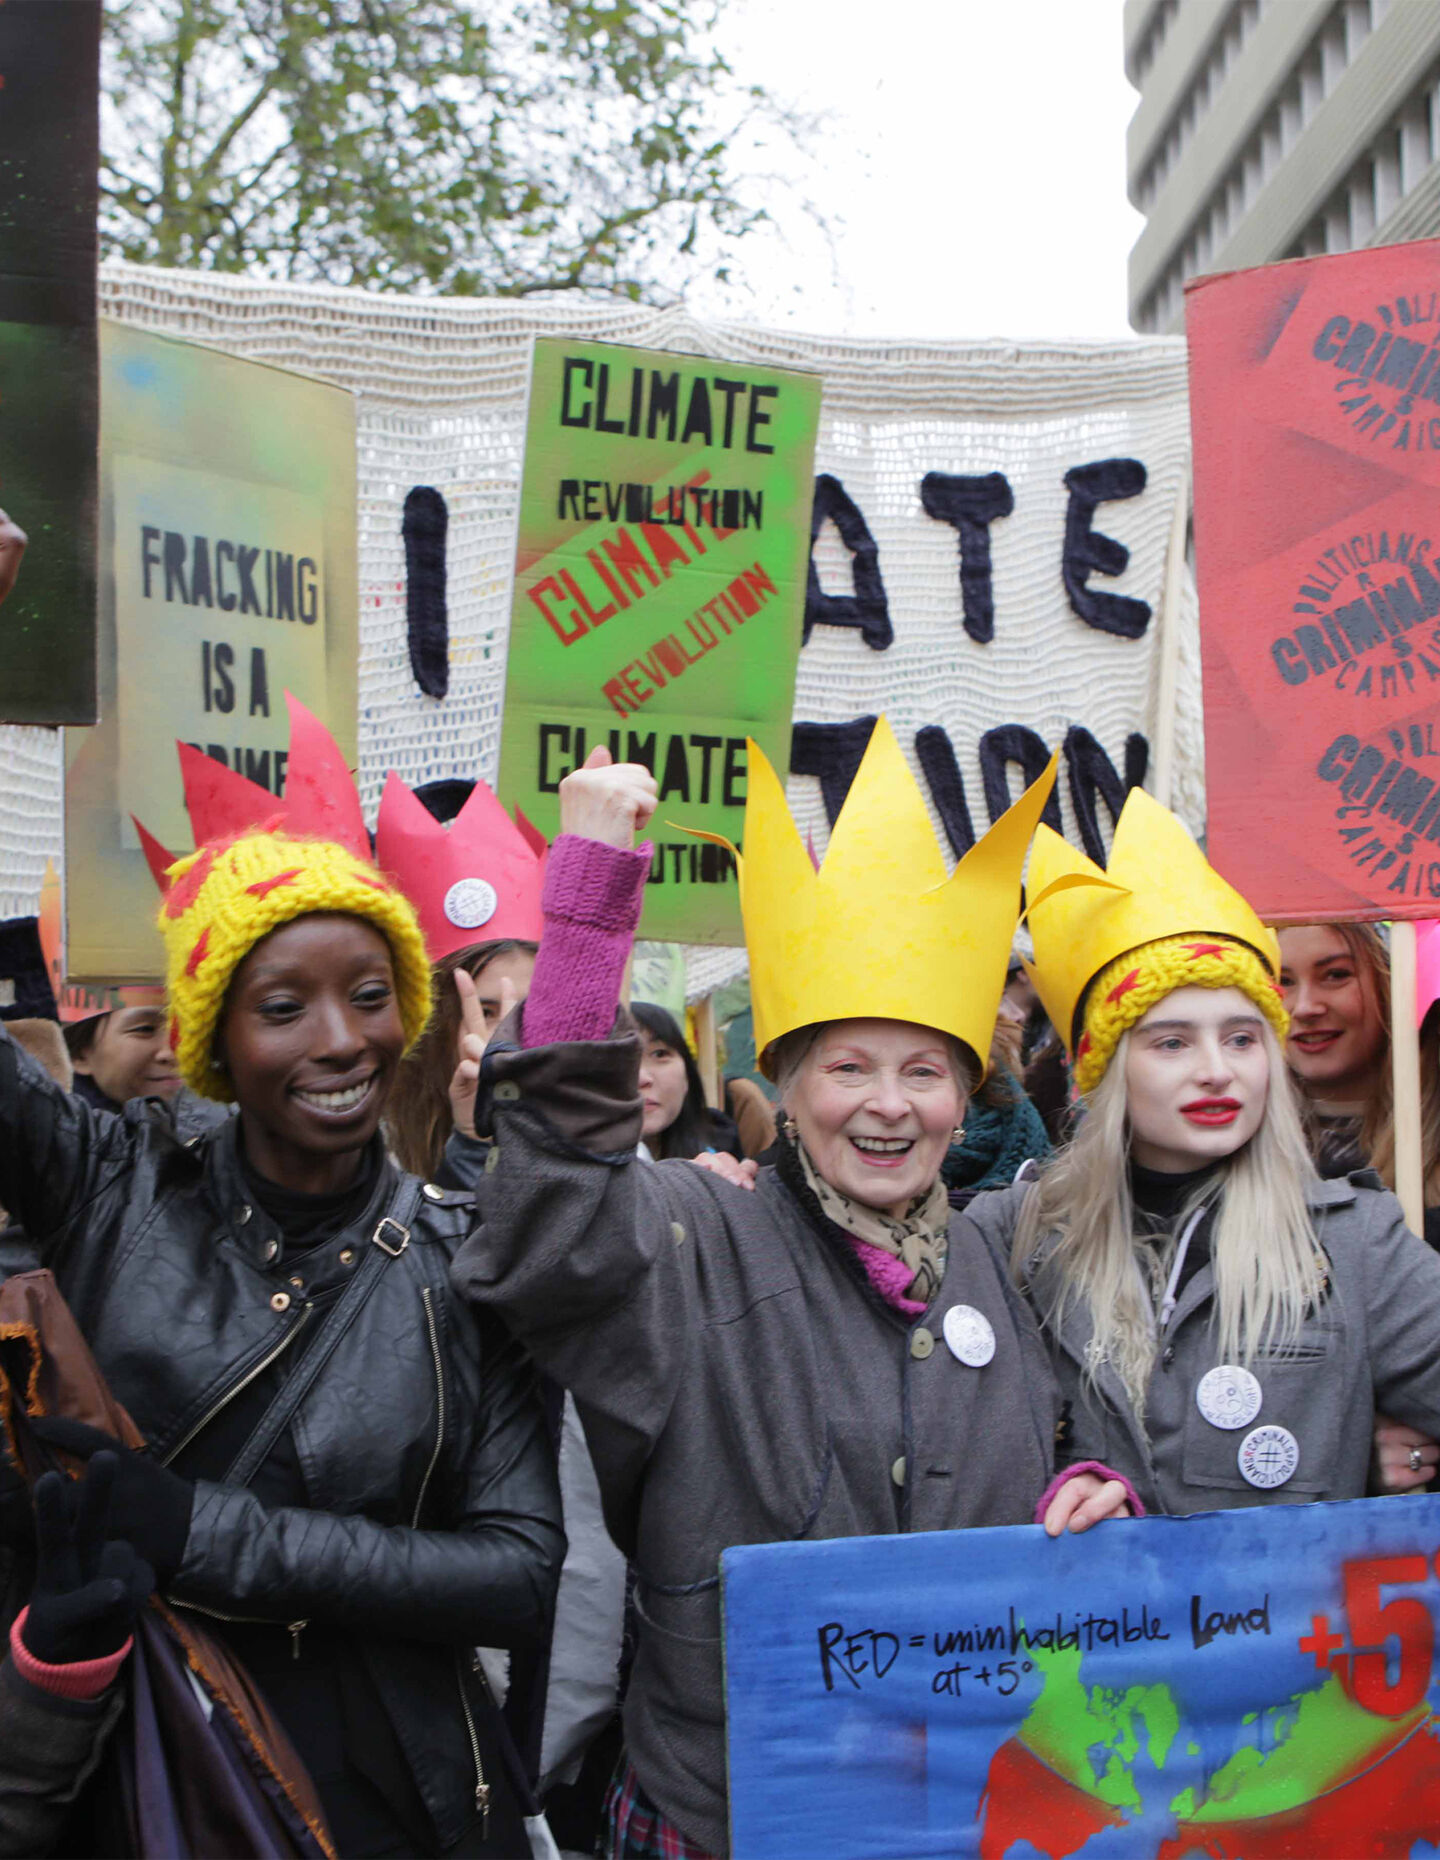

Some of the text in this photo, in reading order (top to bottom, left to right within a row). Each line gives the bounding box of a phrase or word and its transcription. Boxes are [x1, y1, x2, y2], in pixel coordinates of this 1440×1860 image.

[560, 357, 779, 455] CLIMATE
[558, 479, 763, 531] REVOLUTION
[141, 526, 318, 625] FRACKING
[526, 468, 740, 647] CLIMATE
[1293, 531, 1432, 614] POLITICIANS
[601, 561, 780, 719] REVOLUTION
[1271, 557, 1440, 686] CRIMINA
[202, 640, 270, 718] IS A
[818, 1622, 899, 1692] RED
[1191, 1593, 1271, 1650] Land
[931, 1661, 971, 1697] at
